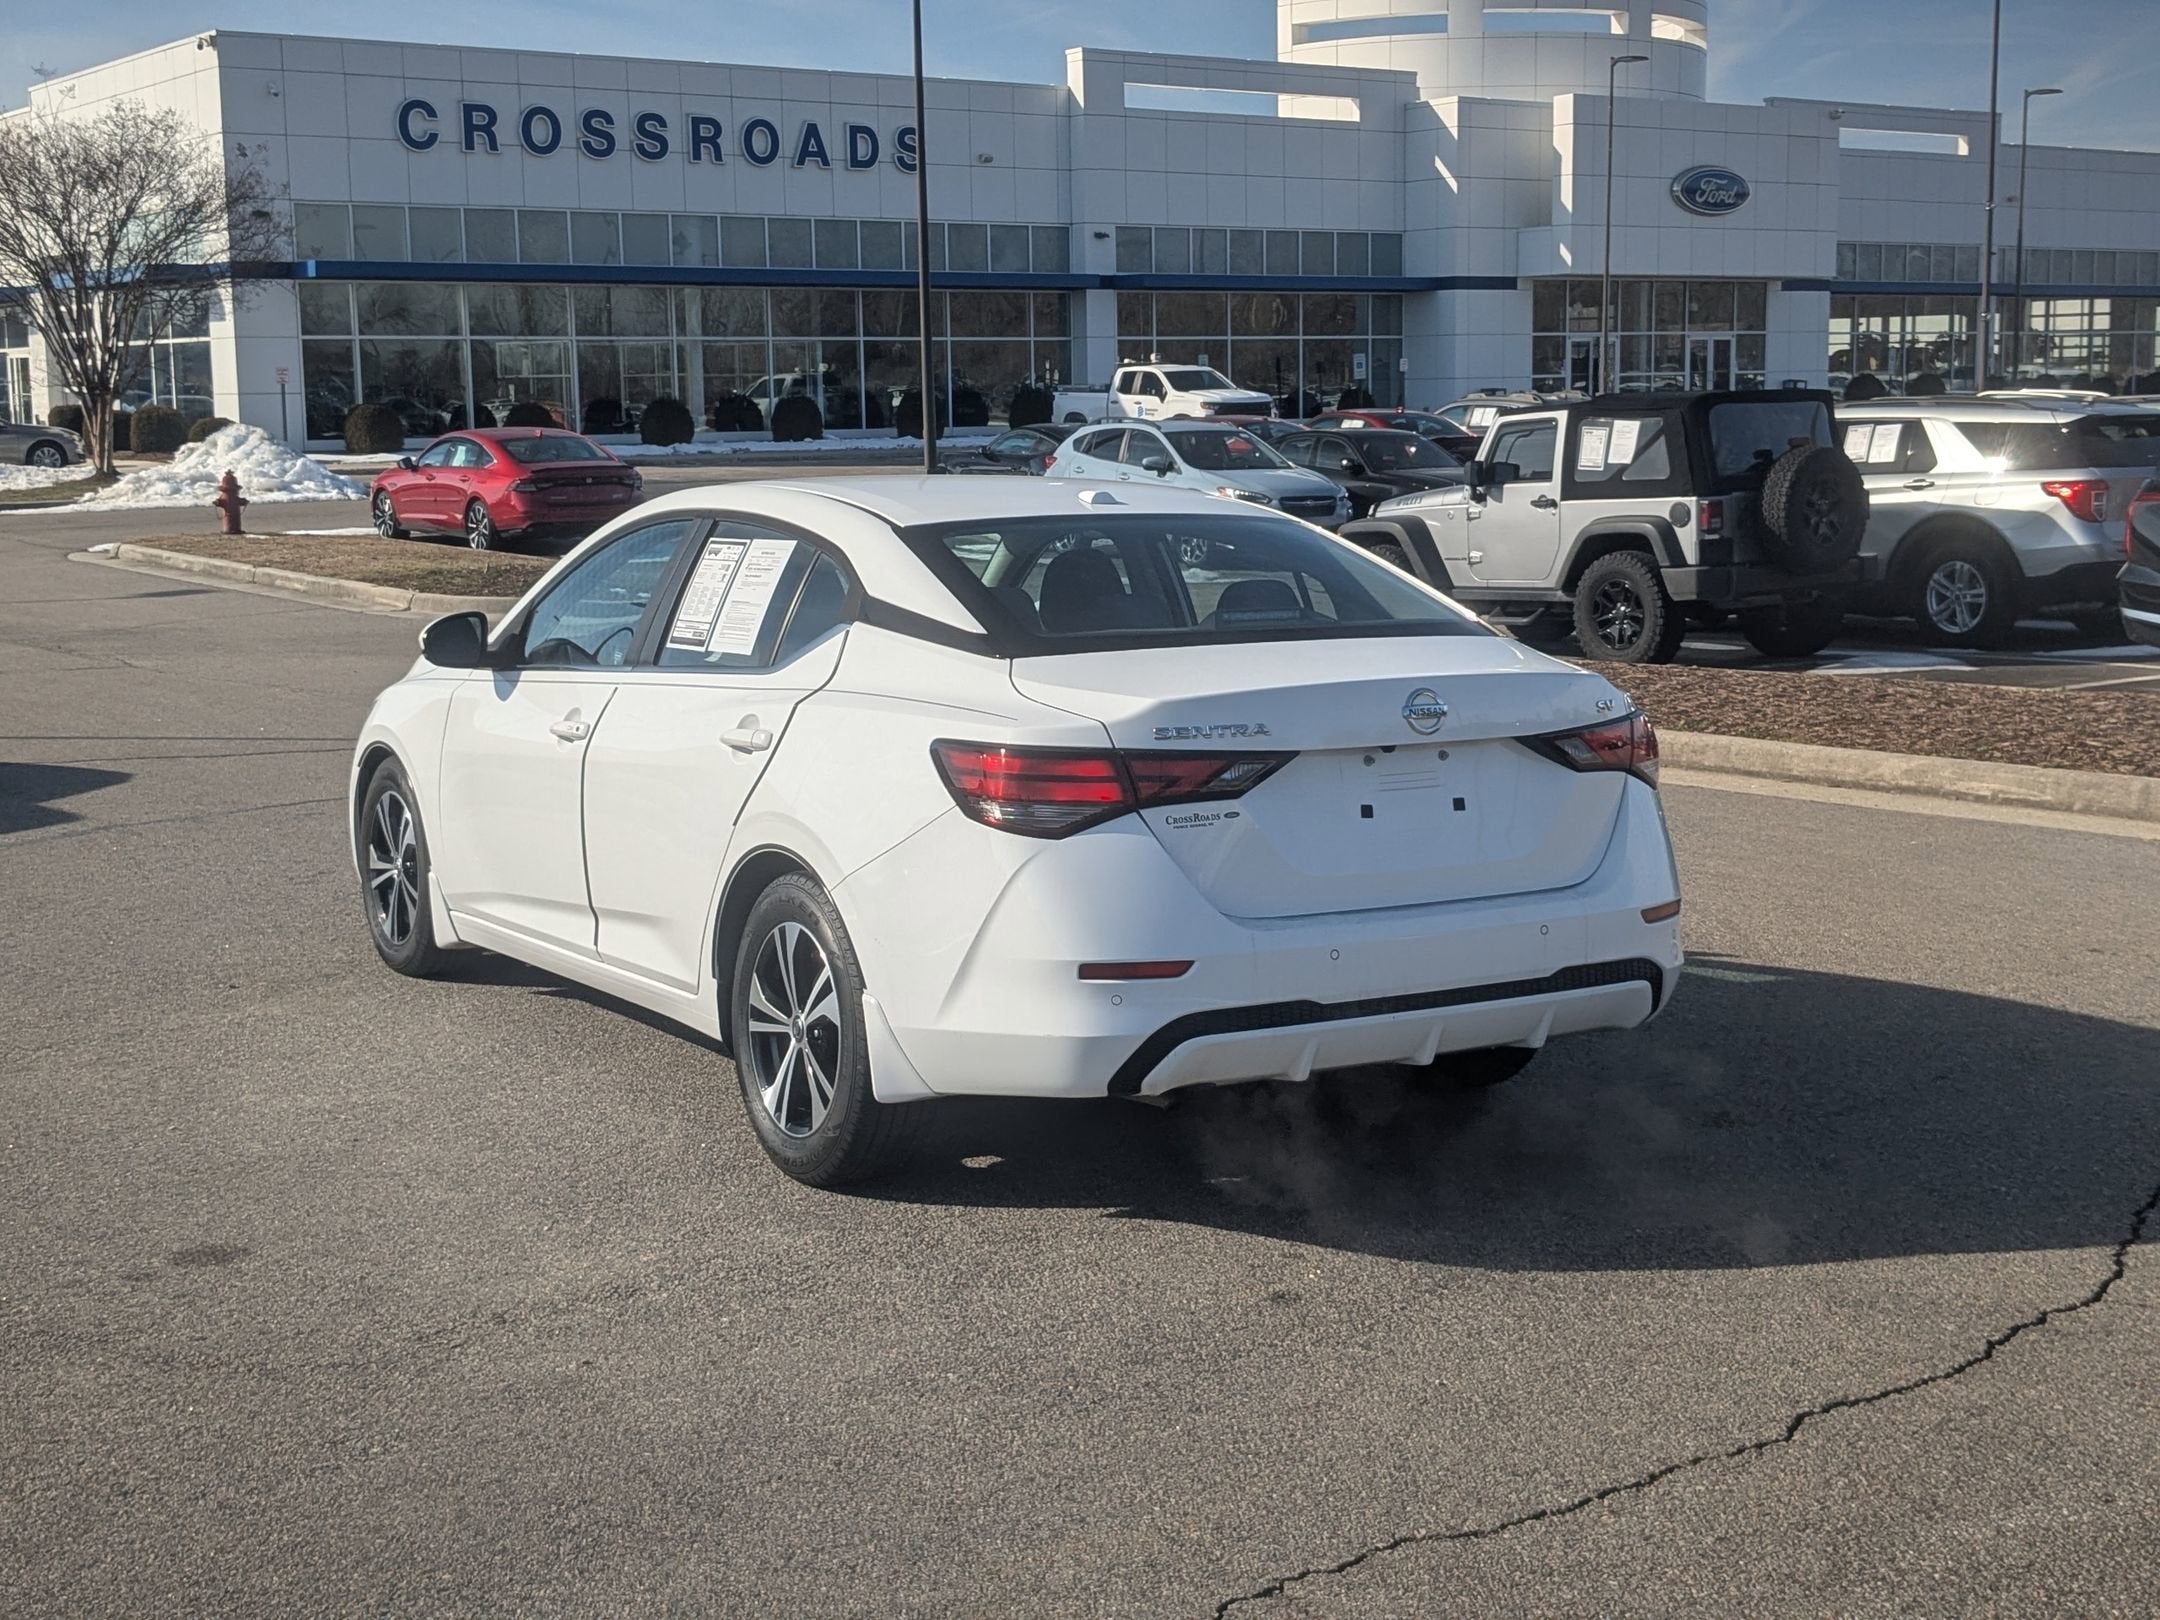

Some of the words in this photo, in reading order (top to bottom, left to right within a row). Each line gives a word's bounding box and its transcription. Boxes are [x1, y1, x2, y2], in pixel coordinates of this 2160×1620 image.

[398, 98, 919, 173] CROSSROADS
[1695, 177, 1738, 204] Ford
[1408, 706, 1446, 718] NISSAN
[1152, 722, 1272, 741] SENTRA
